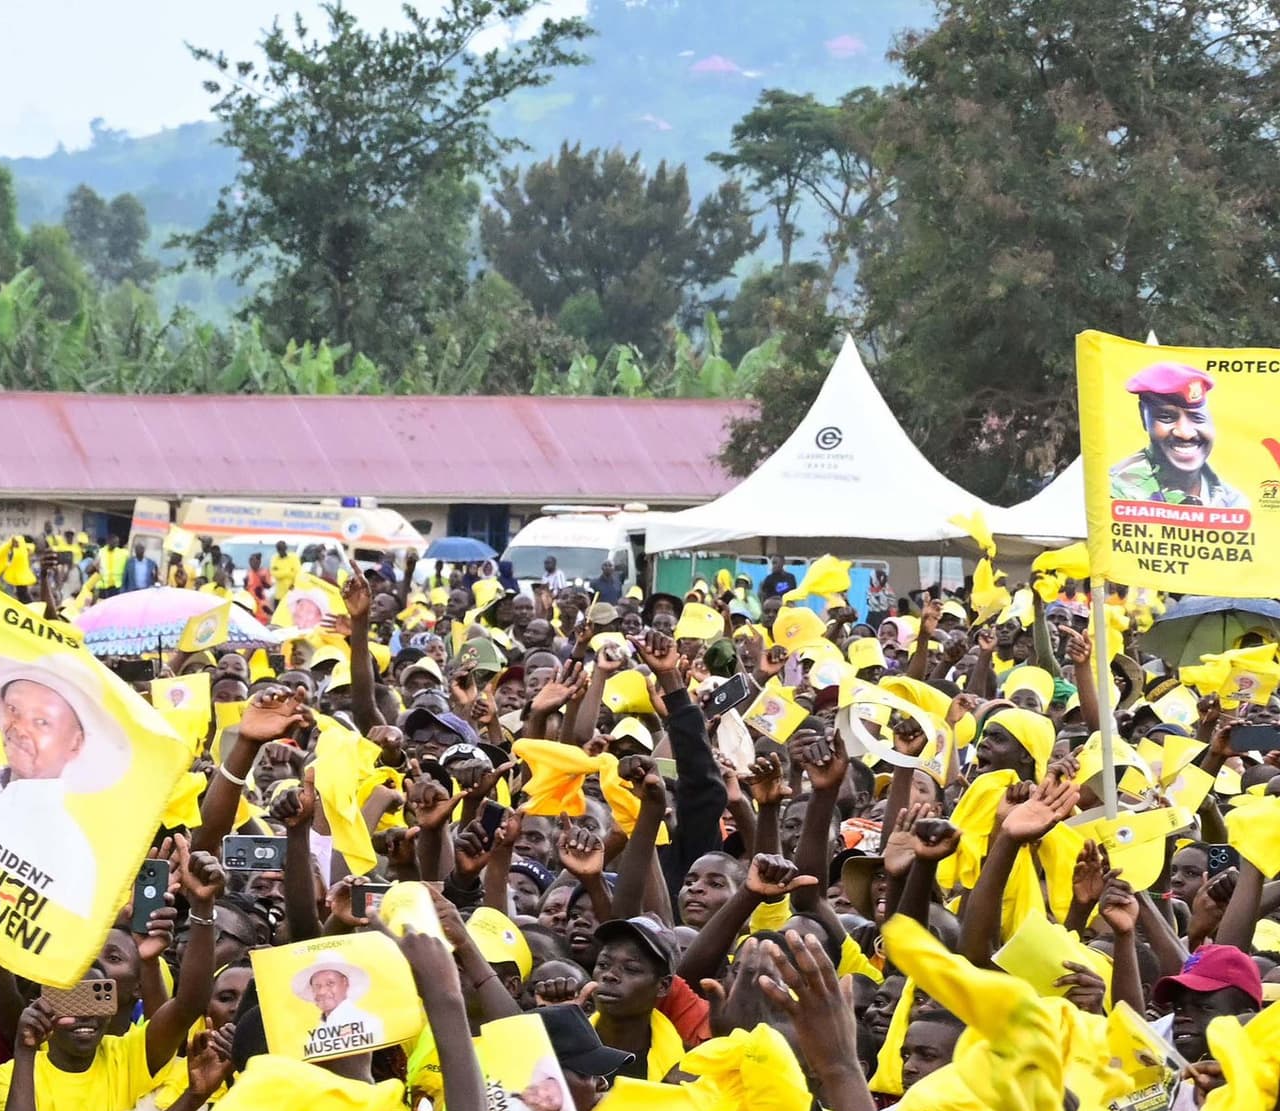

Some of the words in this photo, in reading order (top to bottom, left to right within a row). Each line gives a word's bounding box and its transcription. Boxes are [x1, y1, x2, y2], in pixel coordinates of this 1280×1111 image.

[1114, 505, 1205, 524] CHAIRMAN
[1209, 512, 1244, 524] PLU
[1111, 523, 1153, 539] GEN.
[1162, 527, 1256, 546] MUHOOZI
[1112, 540, 1253, 563] KAINERUGABA
[1138, 557, 1190, 576] NEXT
[307, 1021, 366, 1043] YOWERI
[303, 1031, 375, 1057] MUSEVENI
